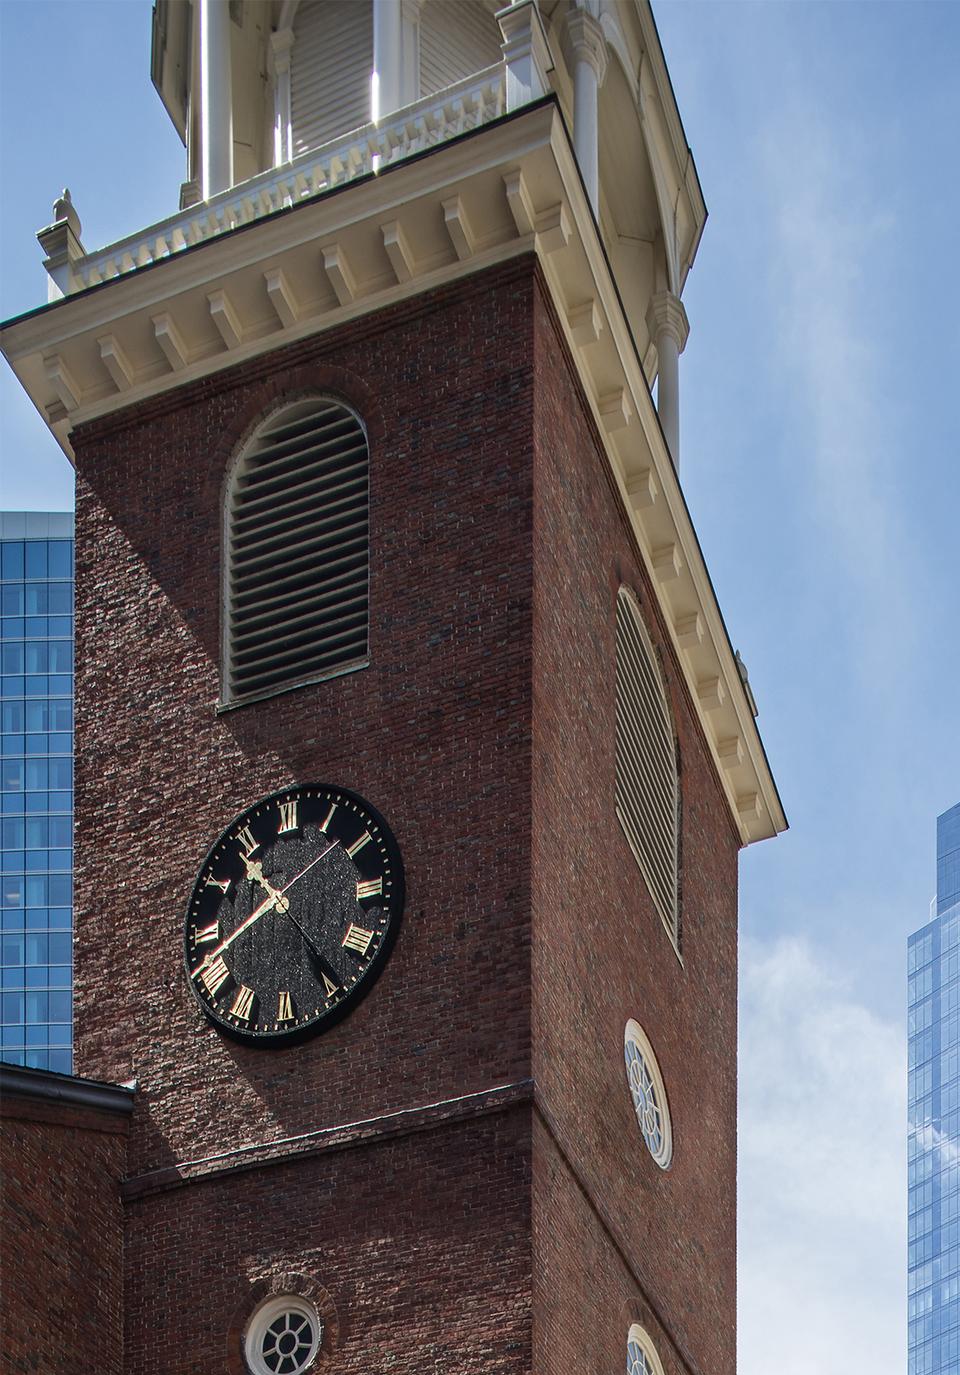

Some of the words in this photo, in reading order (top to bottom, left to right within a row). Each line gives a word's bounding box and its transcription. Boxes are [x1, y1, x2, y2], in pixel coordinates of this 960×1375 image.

[277, 801, 299, 834] XII
[319, 803, 338, 833] I
[345, 830, 373, 860] II
[206, 873, 231, 894] X
[356, 877, 383, 901] III
[342, 923, 374, 956] IIII
